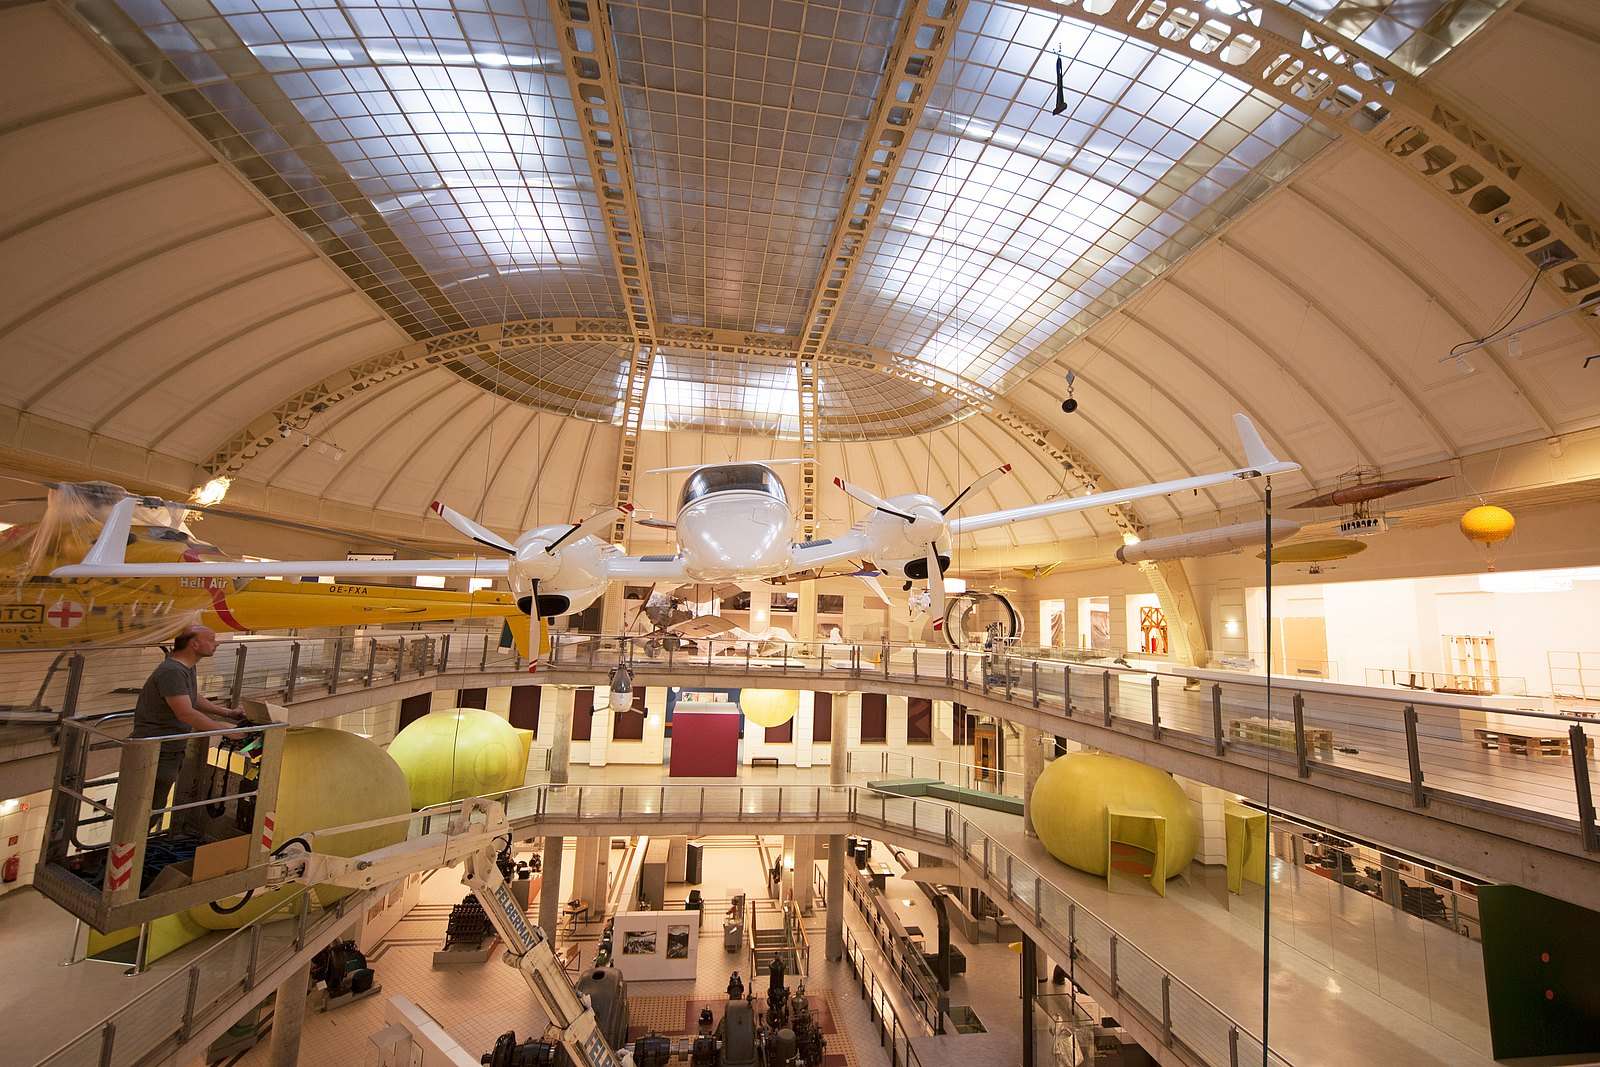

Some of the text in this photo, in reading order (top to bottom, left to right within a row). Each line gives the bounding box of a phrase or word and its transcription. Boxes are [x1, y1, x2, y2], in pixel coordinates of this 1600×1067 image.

[180, 577, 228, 589] Heli Air
[329, 585, 368, 595] OE-FXA
[0, 608, 37, 620] TC
